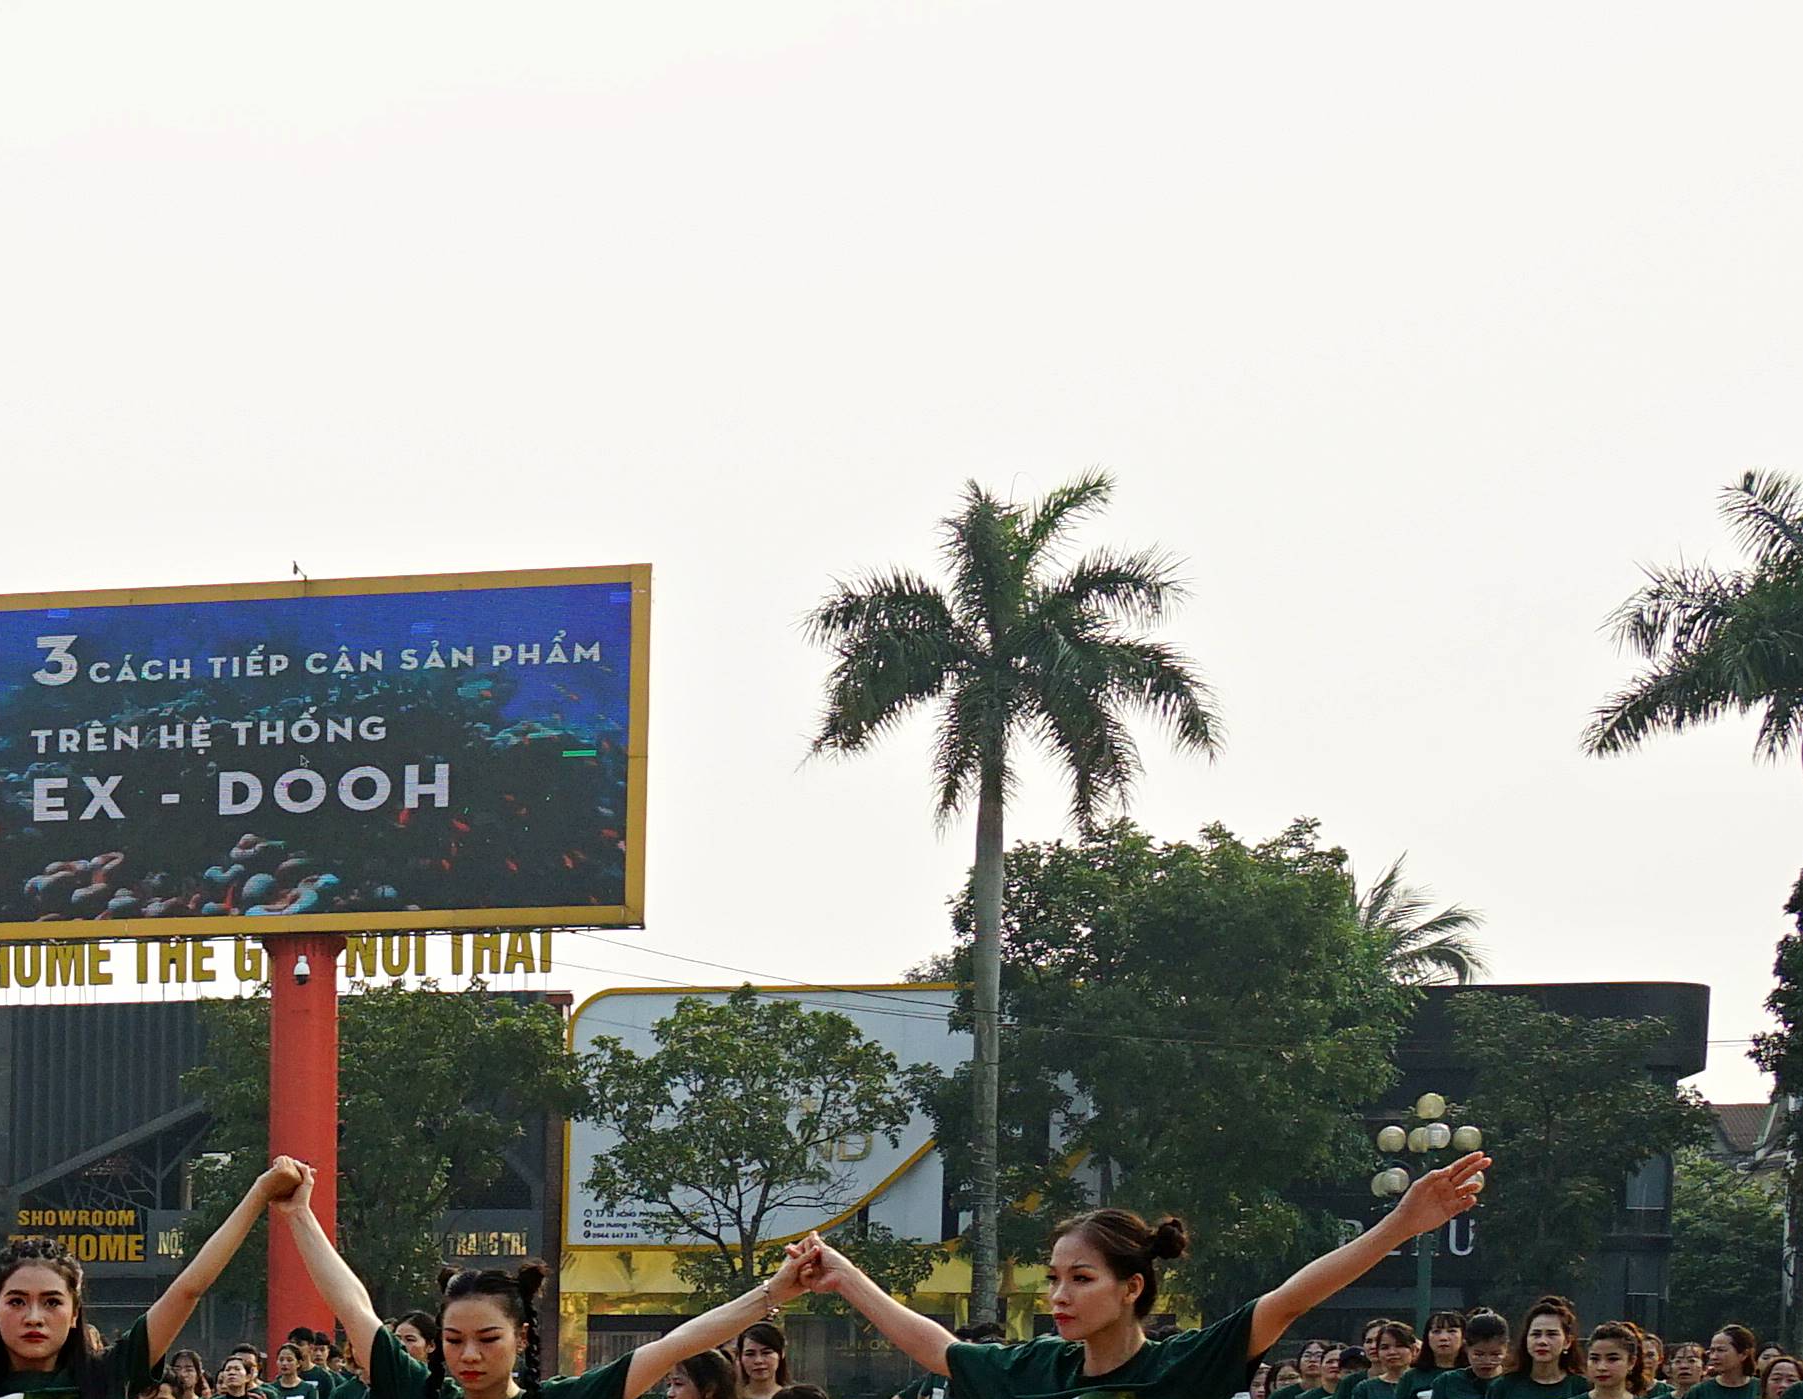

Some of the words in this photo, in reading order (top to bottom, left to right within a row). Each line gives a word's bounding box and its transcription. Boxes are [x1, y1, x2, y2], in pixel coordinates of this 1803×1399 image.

[32, 635, 78, 686] 3
[89, 654, 191, 683] CÁCH
[208, 643, 289, 679] TIẾP
[305, 645, 383, 680] CẬN
[399, 640, 474, 670] SẢN
[492, 630, 601, 666] PHẨM
[31, 719, 139, 754] TRÊN
[158, 716, 212, 755] HỆ
[231, 706, 387, 746] THỐNG
[33, 775, 126, 822] EX
[218, 763, 450, 816] DOOH
[18, 1209, 136, 1227] SHOWROOM
